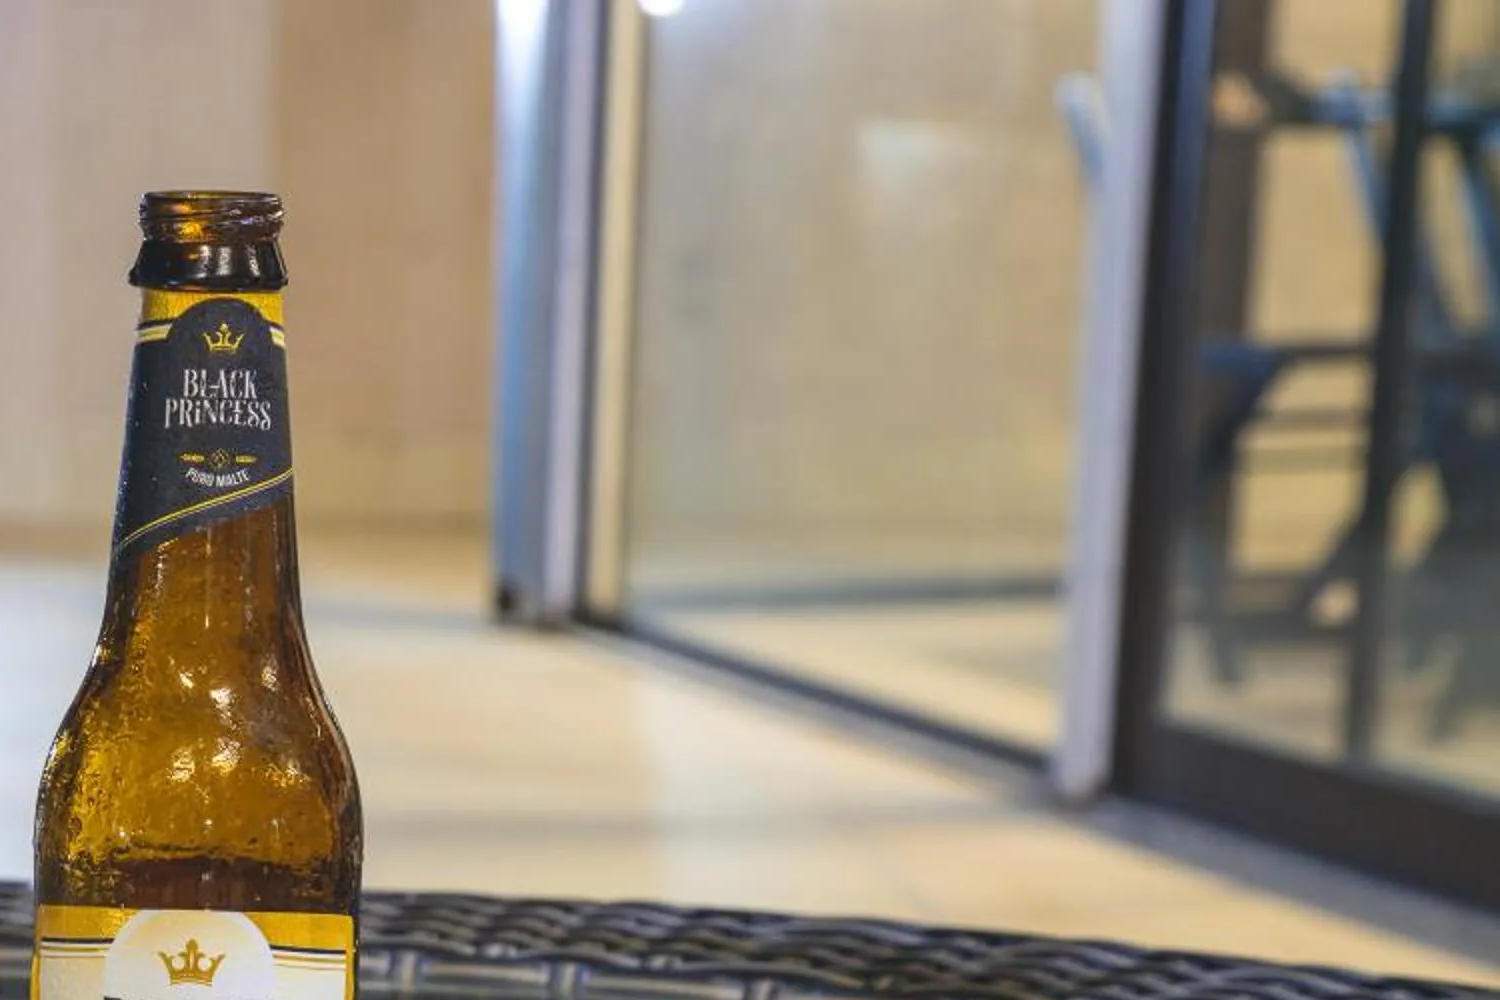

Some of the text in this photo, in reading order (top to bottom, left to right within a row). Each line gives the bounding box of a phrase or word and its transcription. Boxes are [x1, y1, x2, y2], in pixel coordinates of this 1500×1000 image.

[183, 369, 258, 399] BLACK
[185, 467, 250, 487] PURO MALTE
